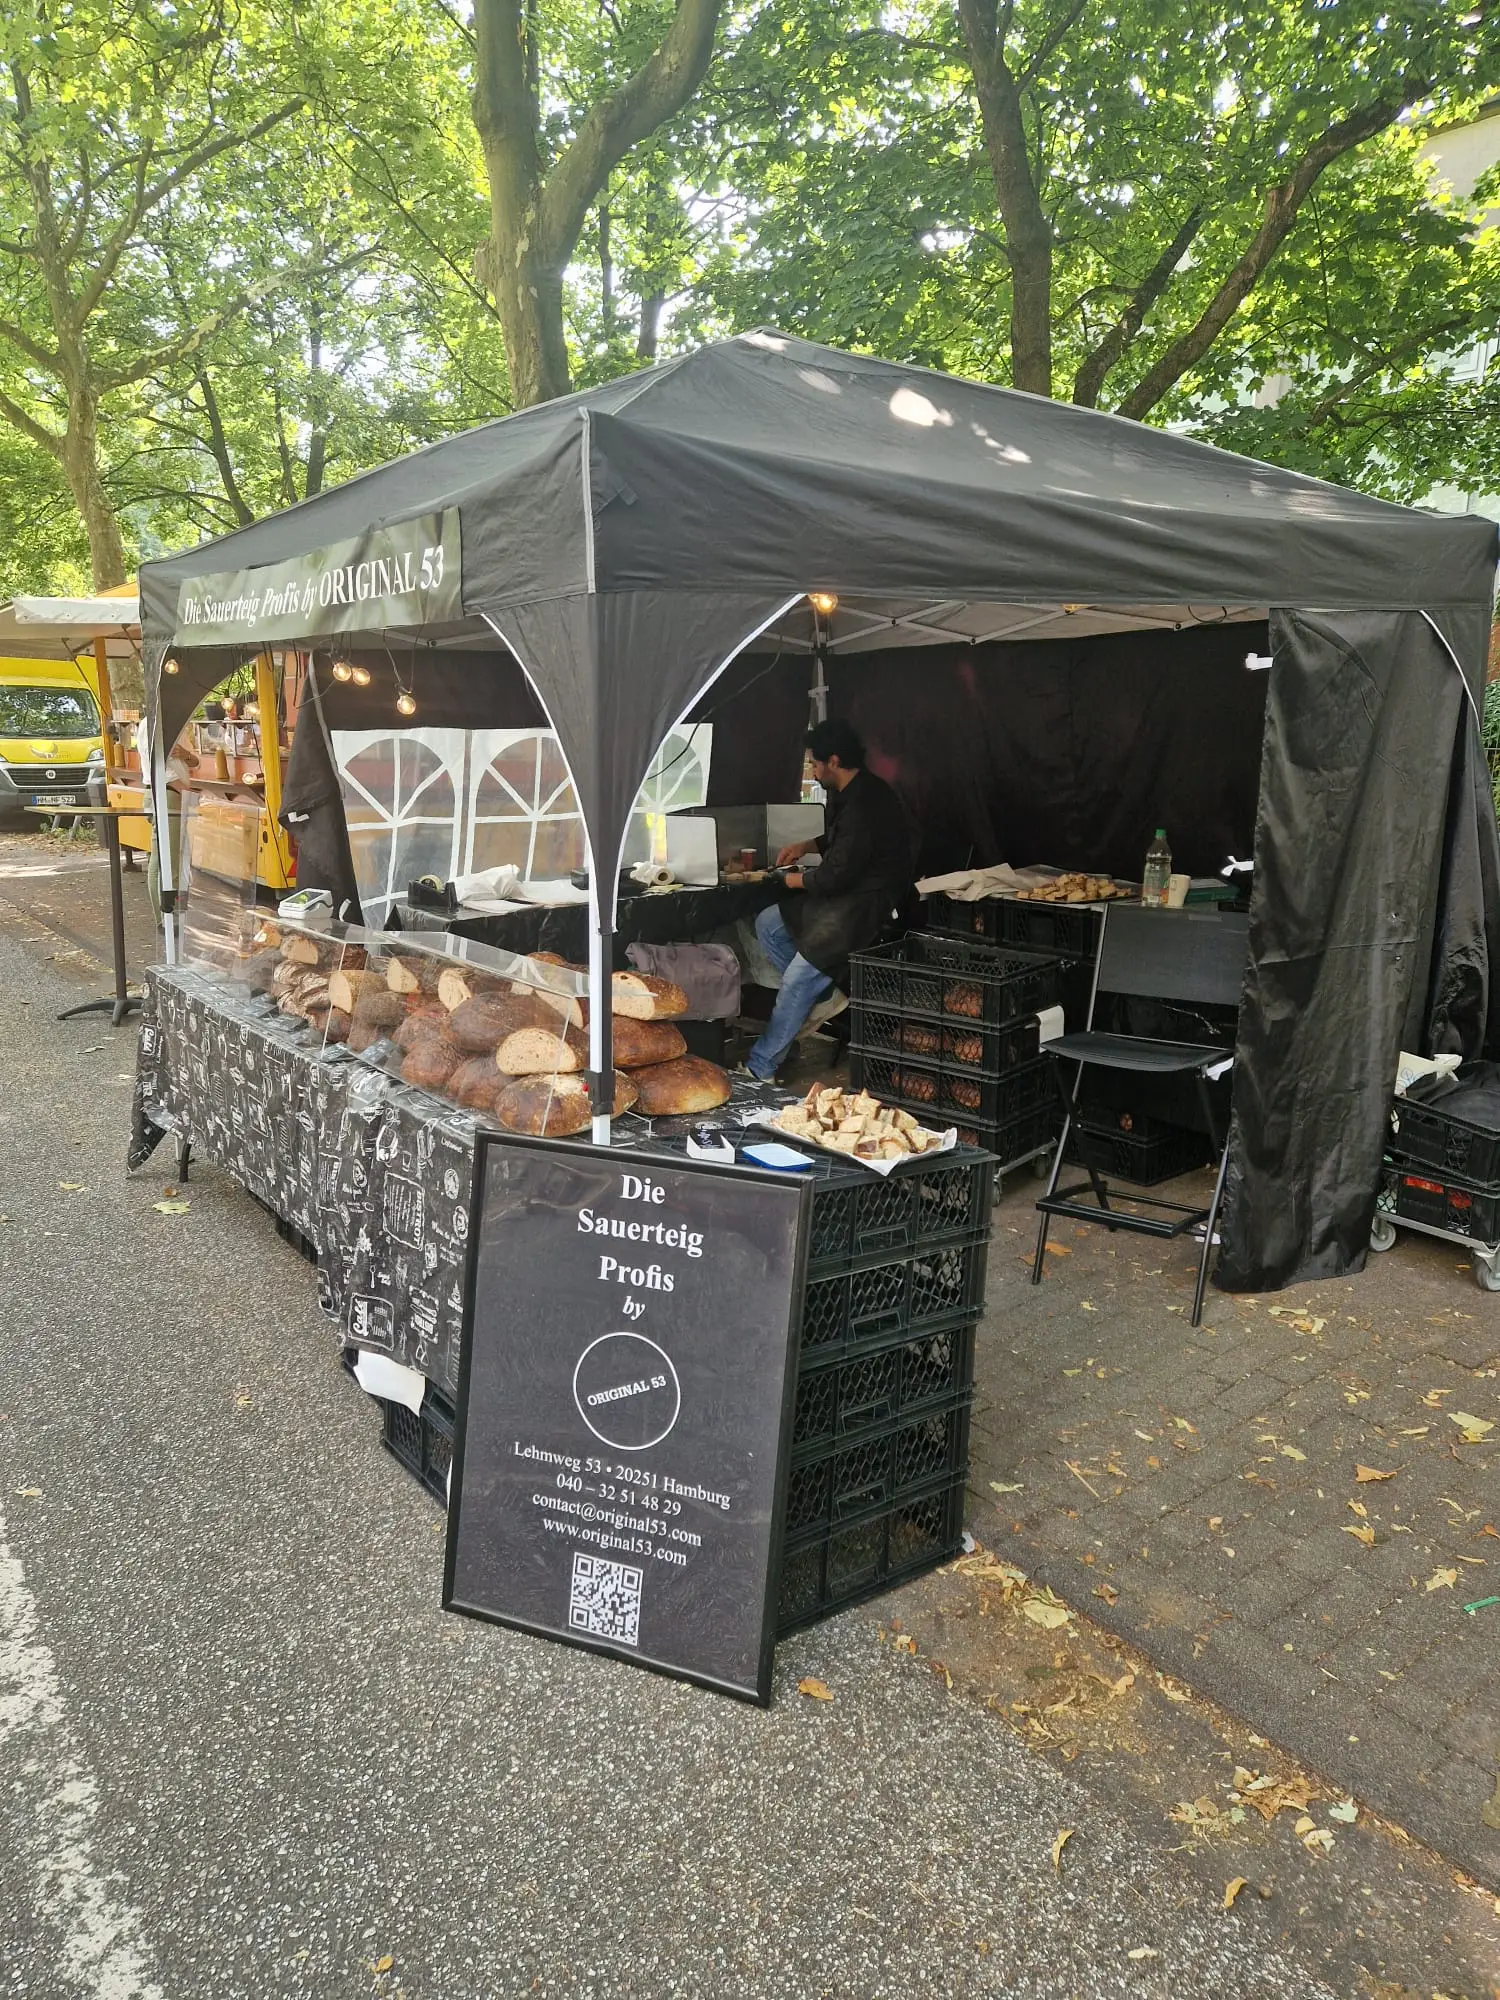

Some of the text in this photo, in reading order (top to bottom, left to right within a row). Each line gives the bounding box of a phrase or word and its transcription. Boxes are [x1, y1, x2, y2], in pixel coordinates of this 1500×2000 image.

[183, 545, 444, 628] Die Sauerteig Profis by ORIGINAL 53
[619, 1174, 666, 1204] Die
[577, 1208, 704, 1258] Sauerteig
[598, 1255, 675, 1293] Profis
[622, 1296, 646, 1320] by
[587, 1376, 667, 1407] ORIGINAL 53
[514, 1441, 581, 1472] Lehmweg
[585, 1458, 601, 1474] 53
[616, 1465, 658, 1489] 20251
[663, 1477, 732, 1510] Hamburg
[557, 1473, 582, 1493] 040
[599, 1484, 616, 1500] 32
[621, 1489, 636, 1505] 51
[641, 1494, 659, 1511] 48
[664, 1499, 682, 1516] 29
[532, 1493, 702, 1547] contact@original53.com
[543, 1518, 688, 1567] www.original53.com
